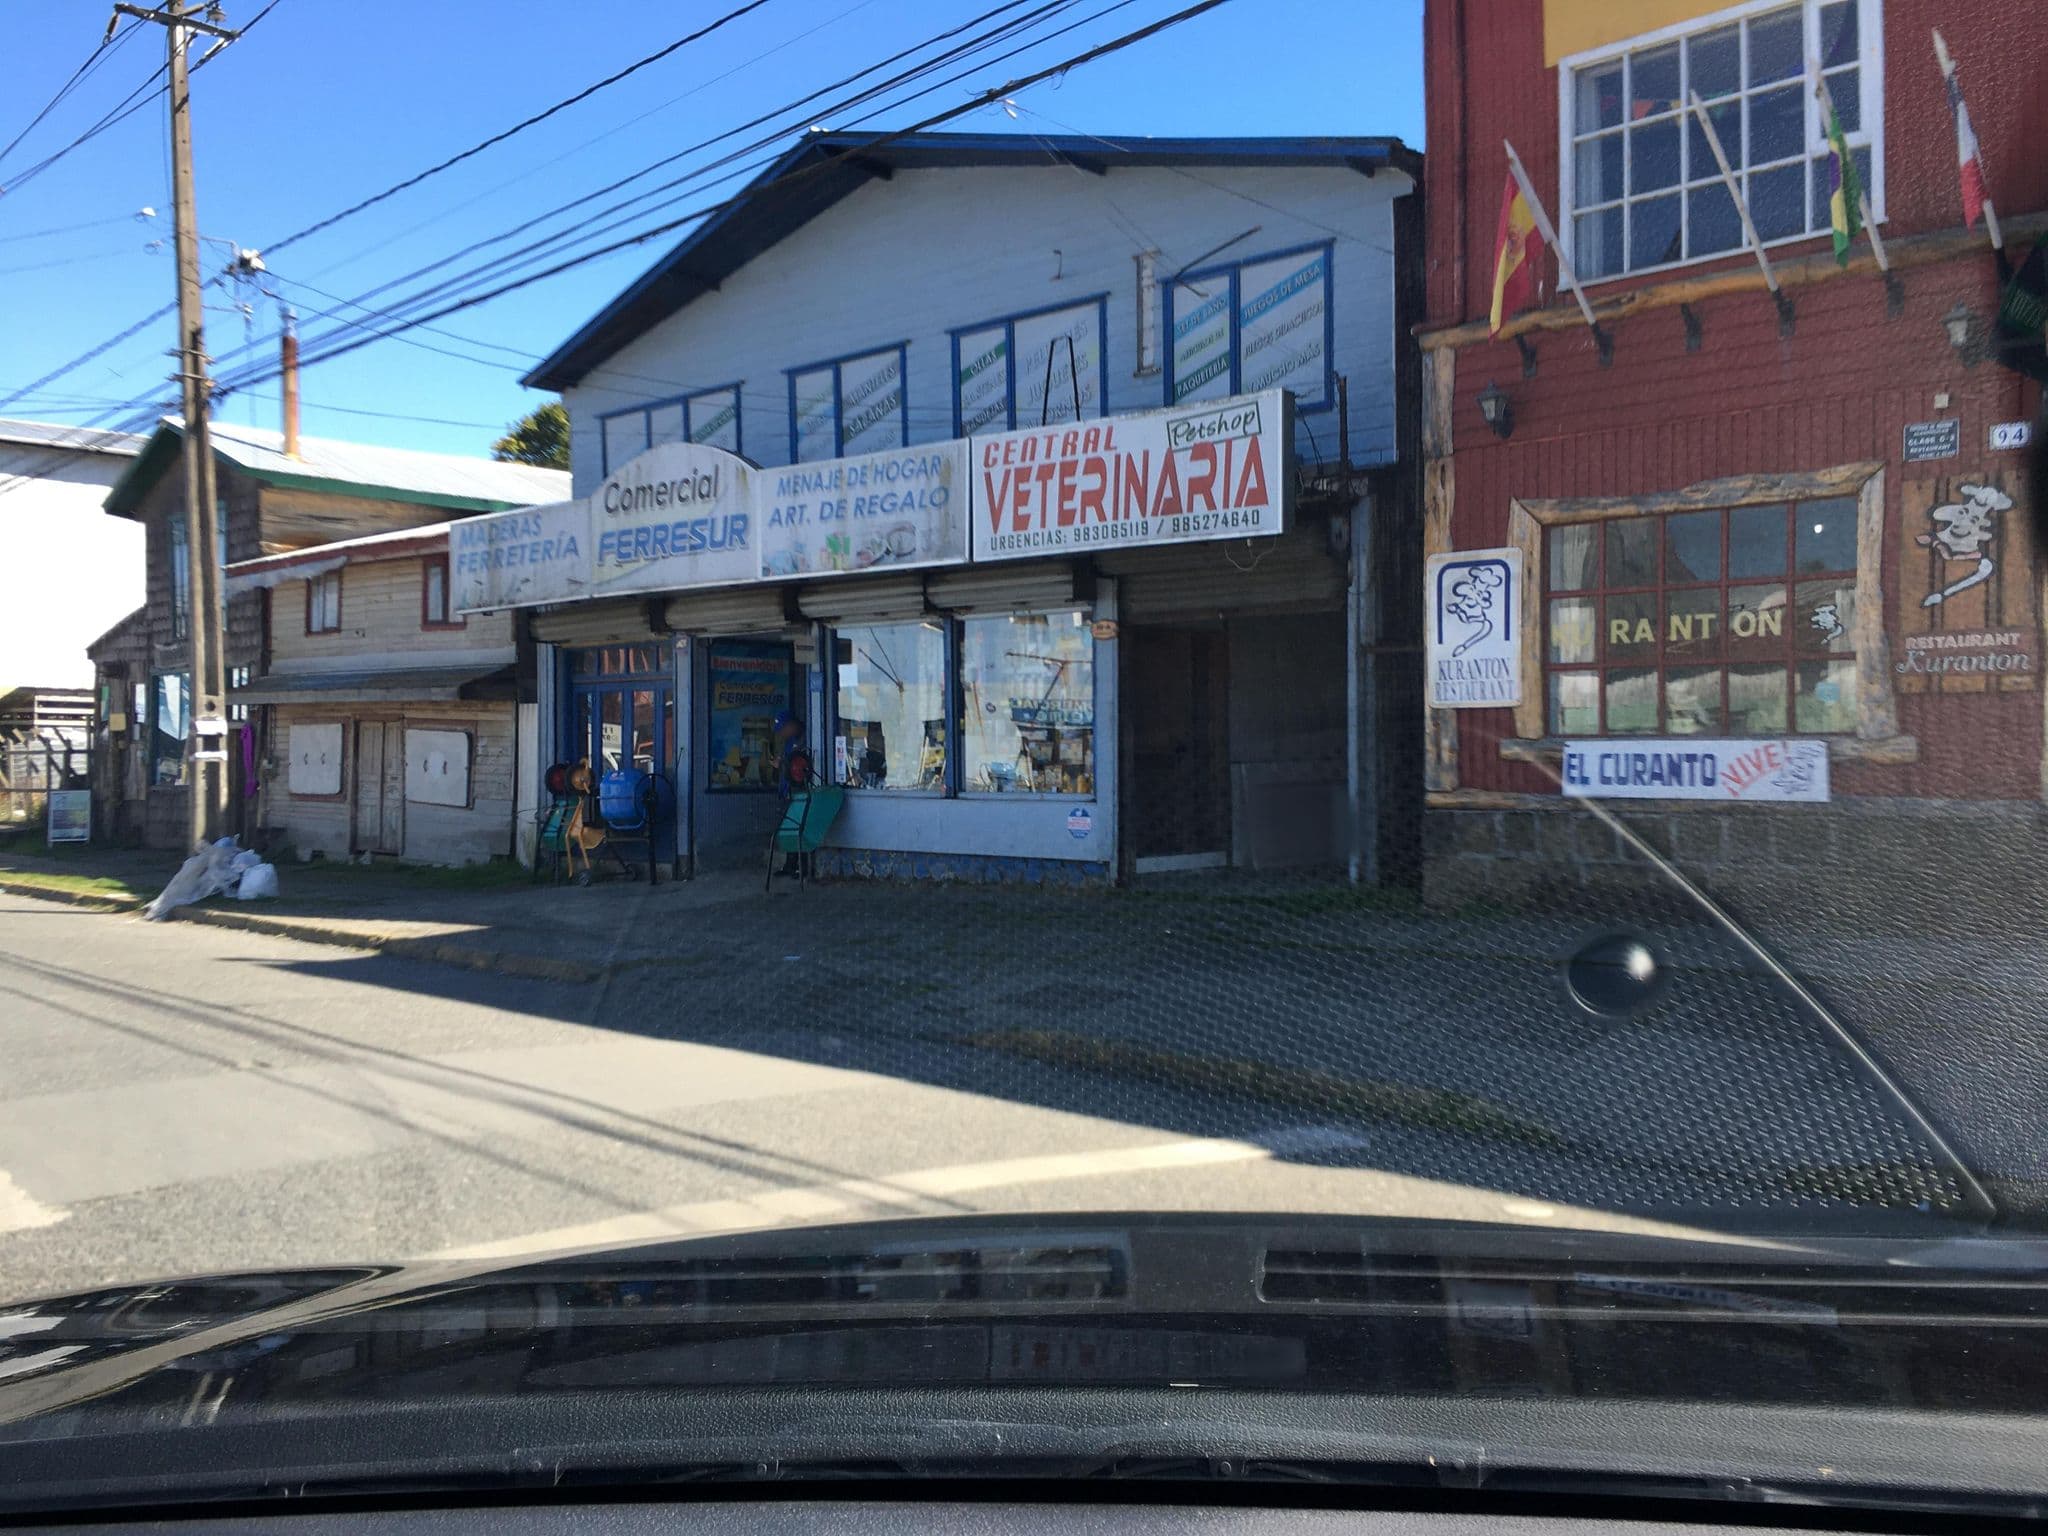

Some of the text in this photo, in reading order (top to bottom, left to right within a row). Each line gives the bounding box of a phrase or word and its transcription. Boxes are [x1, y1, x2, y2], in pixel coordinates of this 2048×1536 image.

[983, 425, 1118, 469] CENTRAL
[1171, 409, 1257, 447] Petshop
[1998, 428, 2024, 444] 94
[604, 464, 719, 514] Comercial
[777, 455, 942, 497] MENAJE DE HOGAR
[984, 435, 1269, 534] VETERINARIA
[768, 486, 949, 528] ART. DE REGALO
[460, 512, 542, 547] MADERAS
[598, 513, 749, 565] FERRESUR
[990, 531, 1067, 551] URGENCIAS:
[456, 531, 580, 575] FERRETERÍA
[1905, 632, 2020, 649] RESTAURANT
[1438, 657, 1510, 681] KURANTON
[1896, 650, 2030, 673] Kuranton
[1567, 753, 1591, 786] EL
[1600, 752, 1718, 788] CURANTO
